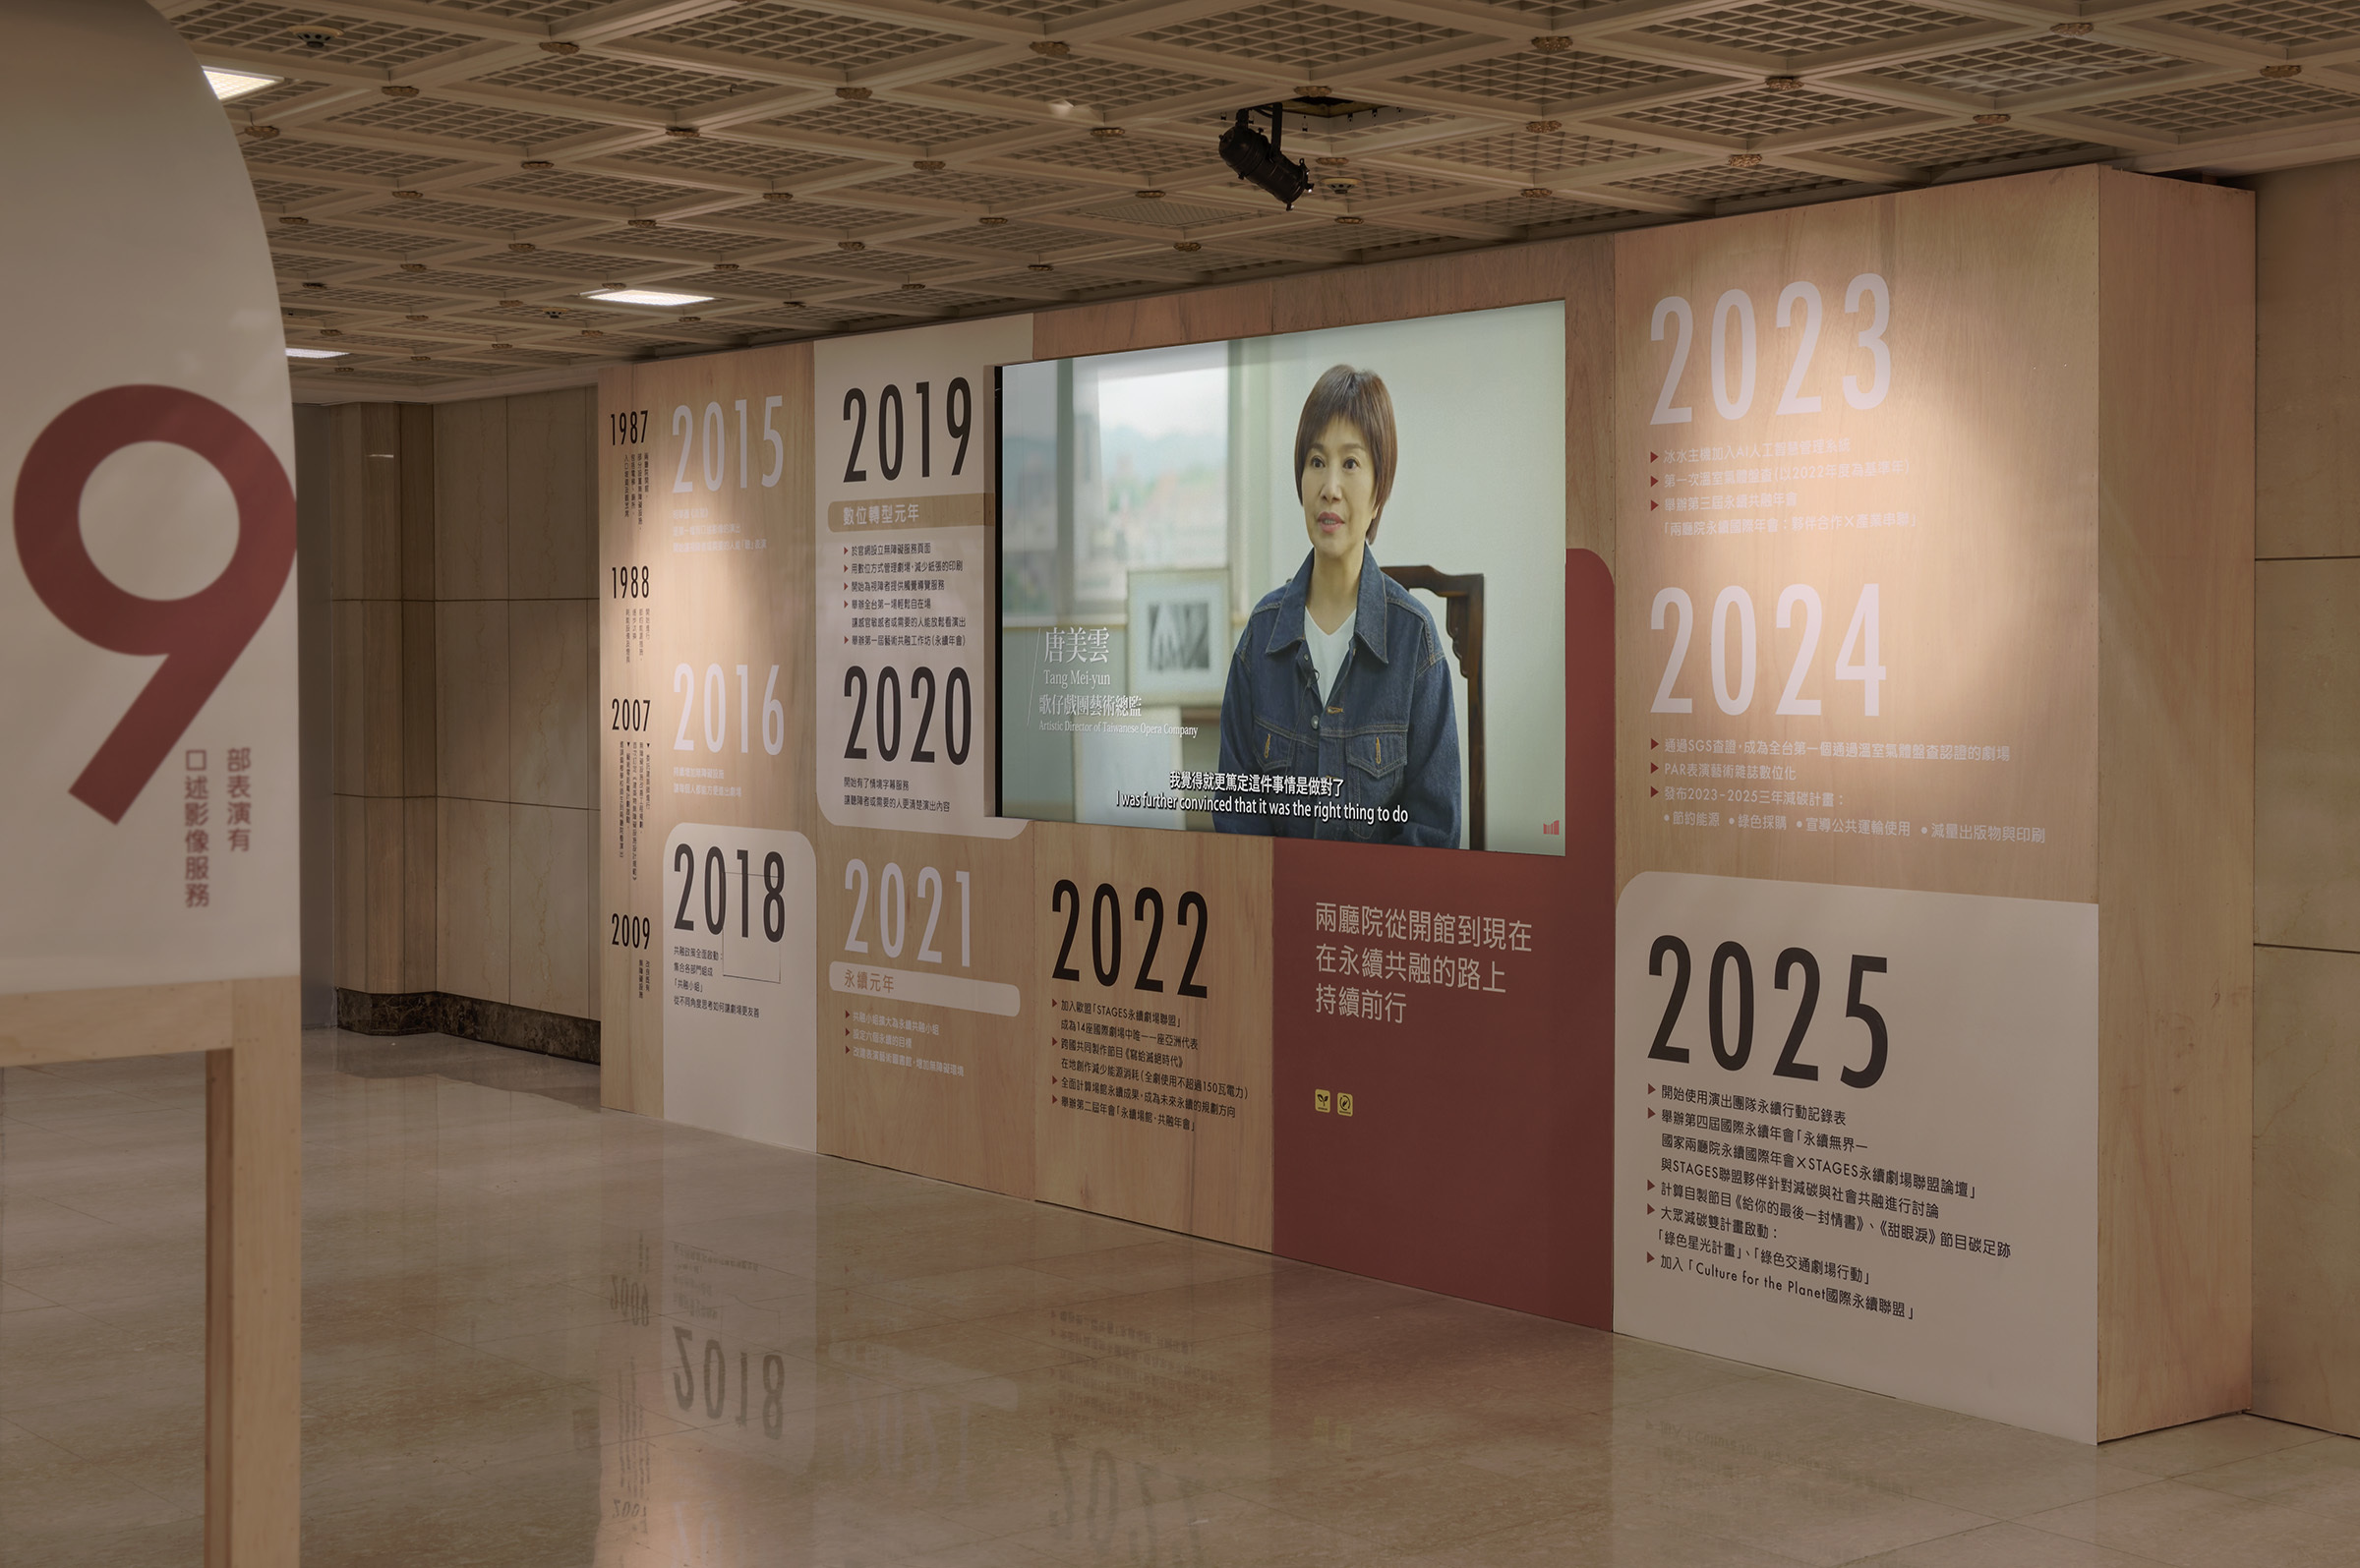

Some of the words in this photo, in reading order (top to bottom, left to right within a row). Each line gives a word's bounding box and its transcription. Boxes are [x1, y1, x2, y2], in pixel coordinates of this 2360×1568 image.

[1650, 273, 1891, 425] 2023
[611, 410, 648, 445] 1987
[673, 395, 784, 494] 2015
[844, 377, 972, 483] 2019
[843, 503, 919, 526] 數位轉型元年
[612, 565, 650, 599] 1988
[14, 383, 296, 826] 9
[1044, 626, 1110, 664] 唐美雲
[1650, 583, 1886, 717] 2024
[1043, 669, 1068, 689] Tang
[1070, 669, 1110, 689] Mei-yun
[612, 698, 651, 731] 2007
[674, 663, 784, 755] 2016
[844, 666, 972, 765] 2020
[1038, 694, 1142, 717] 歌仔戲團藝術總監
[1038, 721, 1063, 731] Artistic
[1064, 721, 1092, 732] Director
[1092, 722, 1101, 732] of
[1102, 722, 1140, 733] Taiwanese
[1141, 723, 1162, 735] Opera
[1163, 723, 1198, 738] Company
[1169, 771, 1344, 797] 我覺得就更篤定這件事情是做對了
[1664, 763, 1797, 782] PAR表演藝術雜誌數位化
[226, 747, 252, 852] 部表演有
[1116, 790, 1119, 806] I
[1122, 794, 1141, 807] was
[1142, 790, 1178, 809] further
[1180, 795, 1232, 812] convinced
[1234, 797, 1258, 814] that
[1259, 798, 1268, 815] it
[1268, 801, 1291, 816] was
[1292, 799, 1312, 817] the
[1314, 801, 1342, 822] right
[1343, 803, 1375, 825] thing
[1377, 806, 1390, 822] to
[1392, 805, 1408, 823] do
[184, 749, 209, 908] 口述影像服務
[1673, 811, 1720, 828] 節約能源
[1738, 813, 1787, 832] 綠色採購
[1805, 817, 1911, 839] 宣導公共運輸使用
[1931, 822, 2045, 844] 減量出版物與印刷
[674, 842, 785, 943] 2018
[845, 858, 970, 967] 2021
[612, 913, 650, 950] 2009
[1052, 879, 1208, 999] 2022
[1316, 901, 1532, 952] 兩廳院從開館到現在
[845, 969, 894, 993] 永續元年
[1316, 943, 1506, 993] 在永續共融的路上
[1316, 983, 1407, 1023] 持續前行
[1648, 935, 1888, 1088] 2025
[1661, 1084, 1847, 1127] 開始使用演出團隊永續行動記錄表
[1661, 1157, 1939, 1219] 與STAGES聯盟夥伴針對減碳與社會共融進行討論
[1741, 1268, 1759, 1287] for
[1763, 1274, 1783, 1293] the
